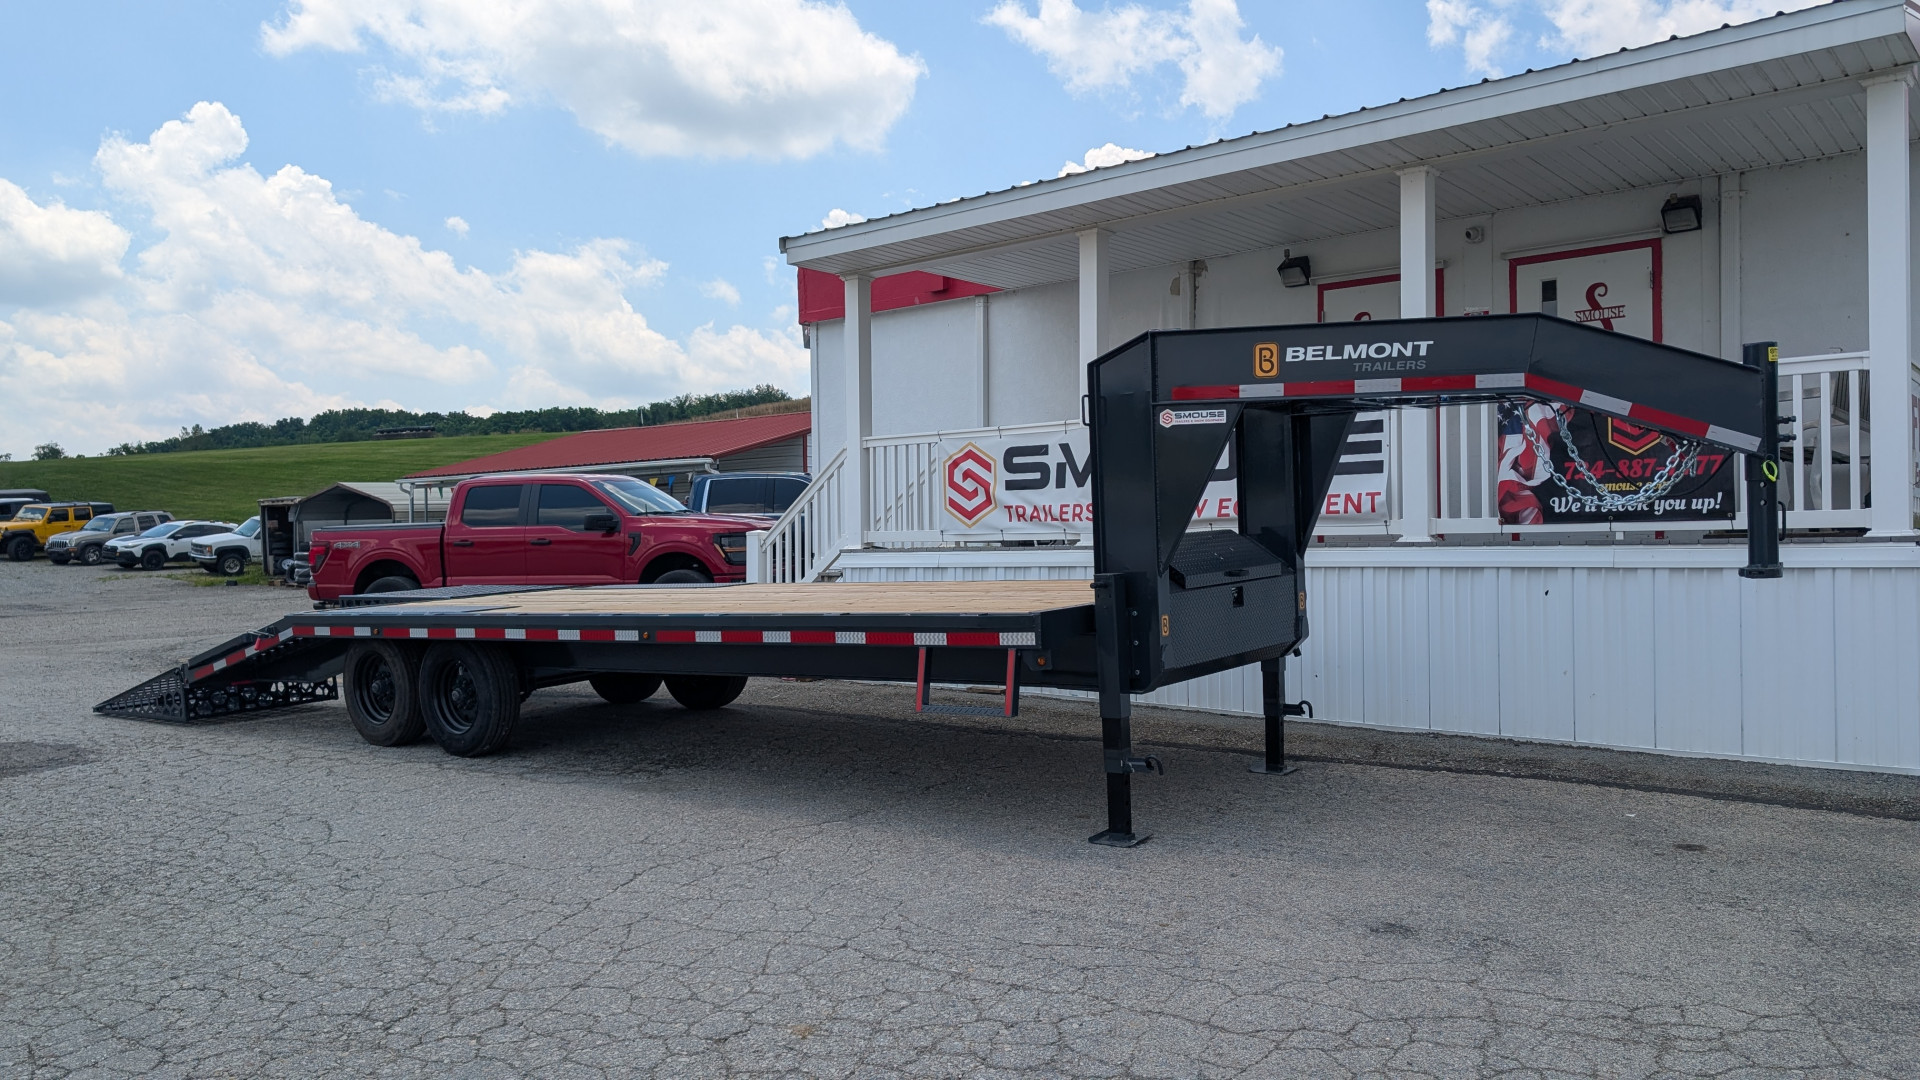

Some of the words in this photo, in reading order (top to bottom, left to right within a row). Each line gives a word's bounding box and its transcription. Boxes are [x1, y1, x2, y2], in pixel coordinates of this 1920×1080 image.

[1575, 305, 1626, 323] SMOUSE
[1285, 340, 1434, 362] BELMONT
[1353, 360, 1427, 372] TRAILERS
[1174, 411, 1225, 419] SMOUSE
[1563, 454, 1725, 480] 724-887-77
[1654, 497, 1686, 515] you
[1691, 491, 1723, 515] up!
